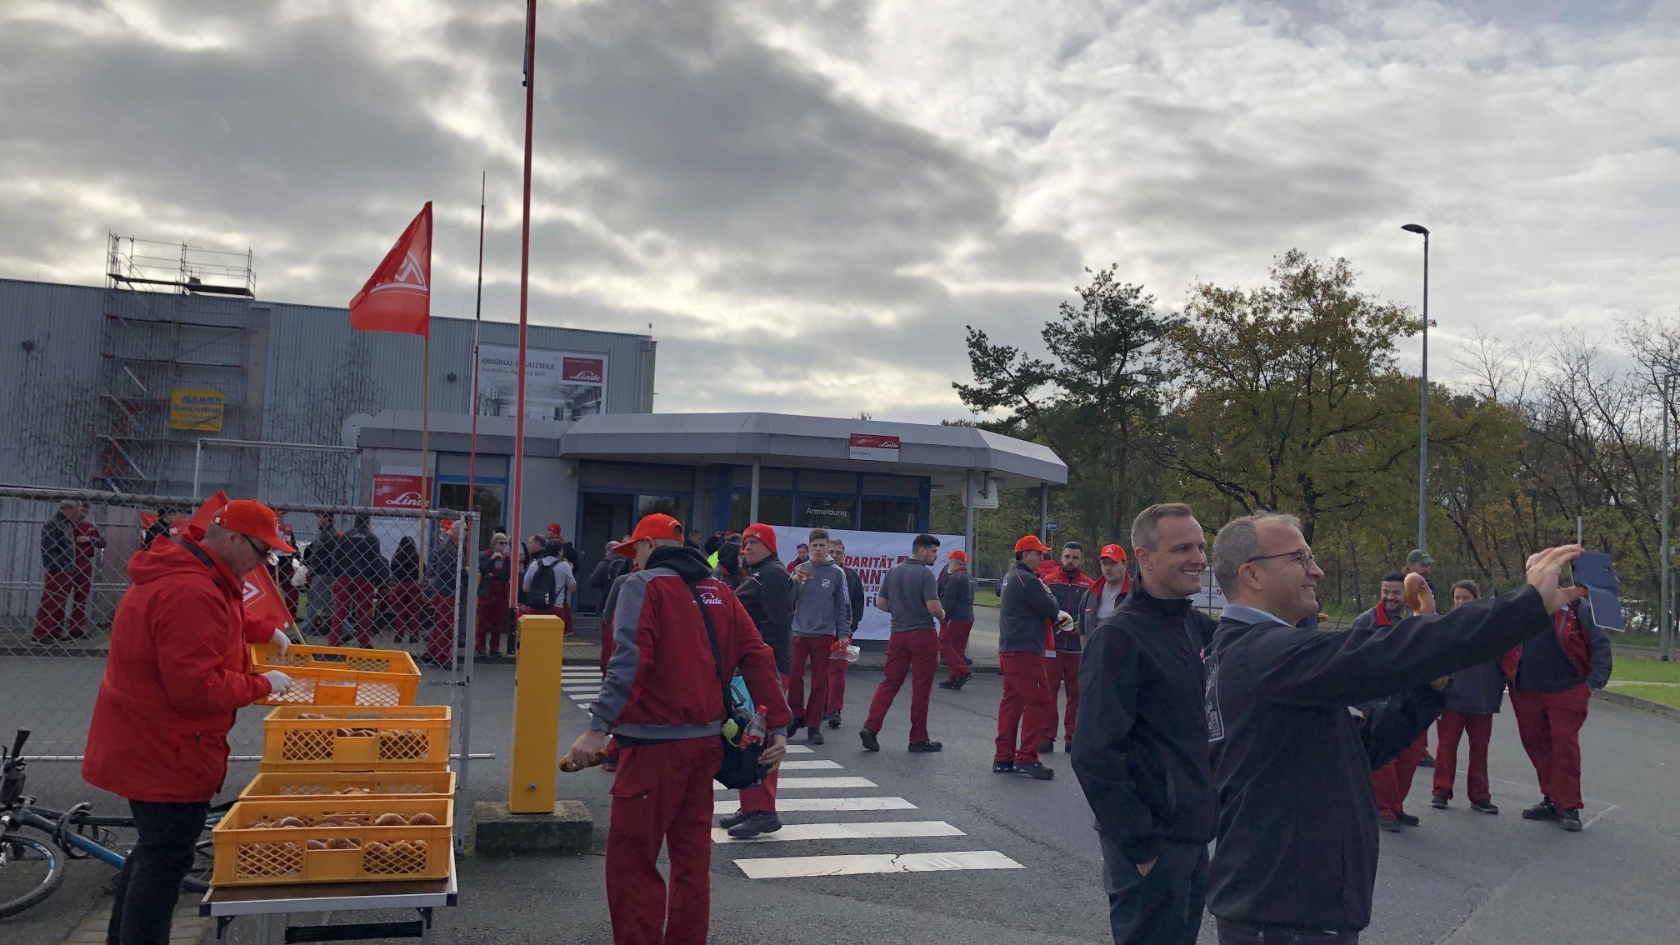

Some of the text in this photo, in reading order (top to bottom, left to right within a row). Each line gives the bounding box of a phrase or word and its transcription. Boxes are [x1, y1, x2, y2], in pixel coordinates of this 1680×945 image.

[482, 358, 554, 370] ORIGINAL-EATZTEILE
[569, 370, 601, 381] Linde
[386, 492, 430, 506] Line
[806, 507, 847, 517] Anmeldung
[844, 554, 894, 569] DARITÄT
